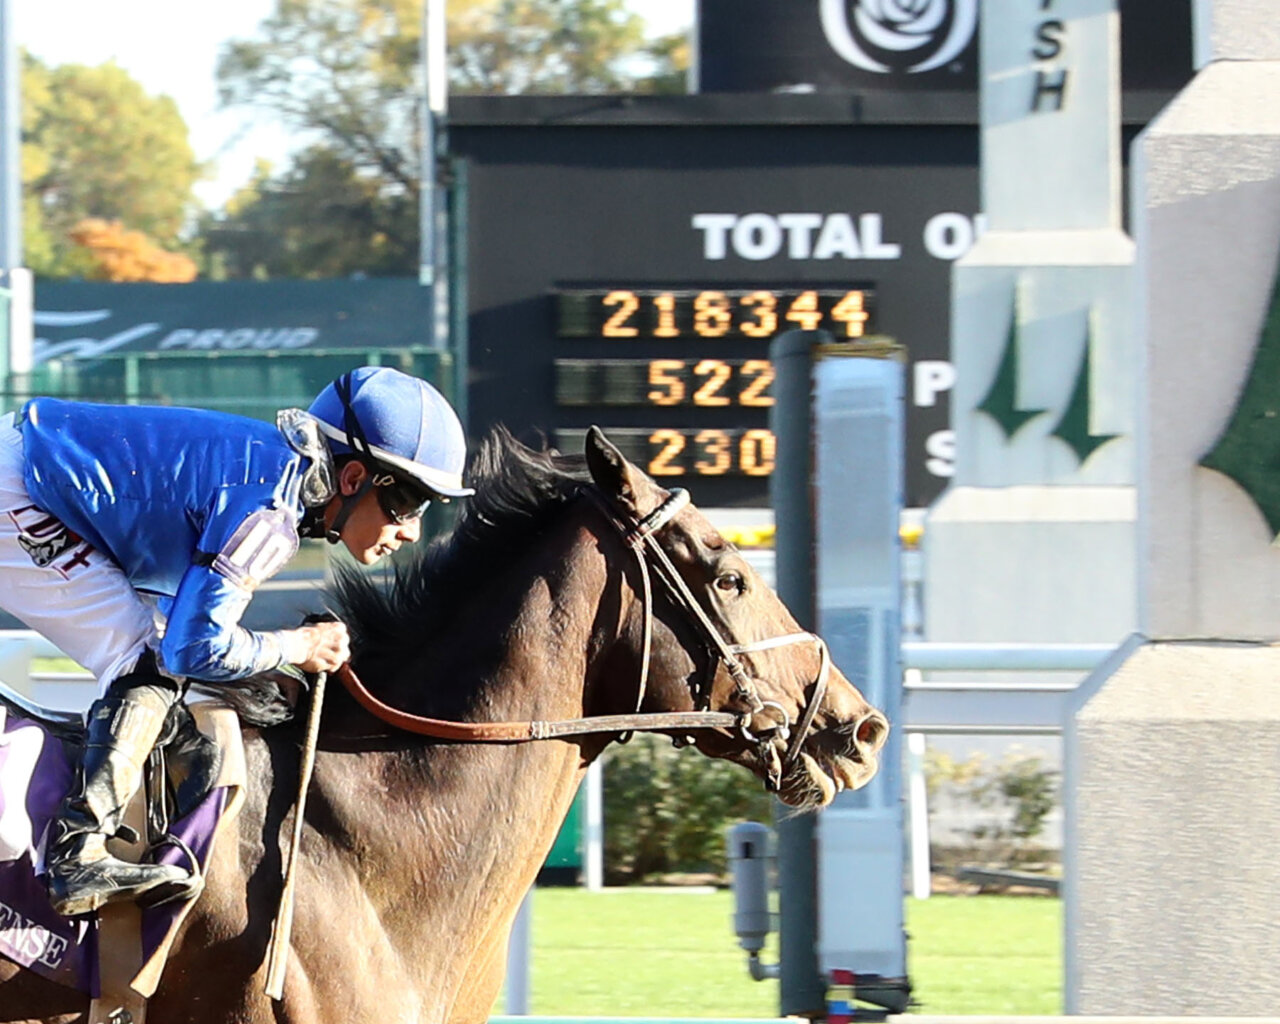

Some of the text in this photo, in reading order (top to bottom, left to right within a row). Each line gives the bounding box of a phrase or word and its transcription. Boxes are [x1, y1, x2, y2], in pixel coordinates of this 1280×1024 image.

[693, 214, 901, 260] TOTAL
[602, 290, 869, 338] 218344
[157, 328, 320, 351] PROUD
[648, 360, 776, 407] 522
[648, 429, 776, 476] 230
